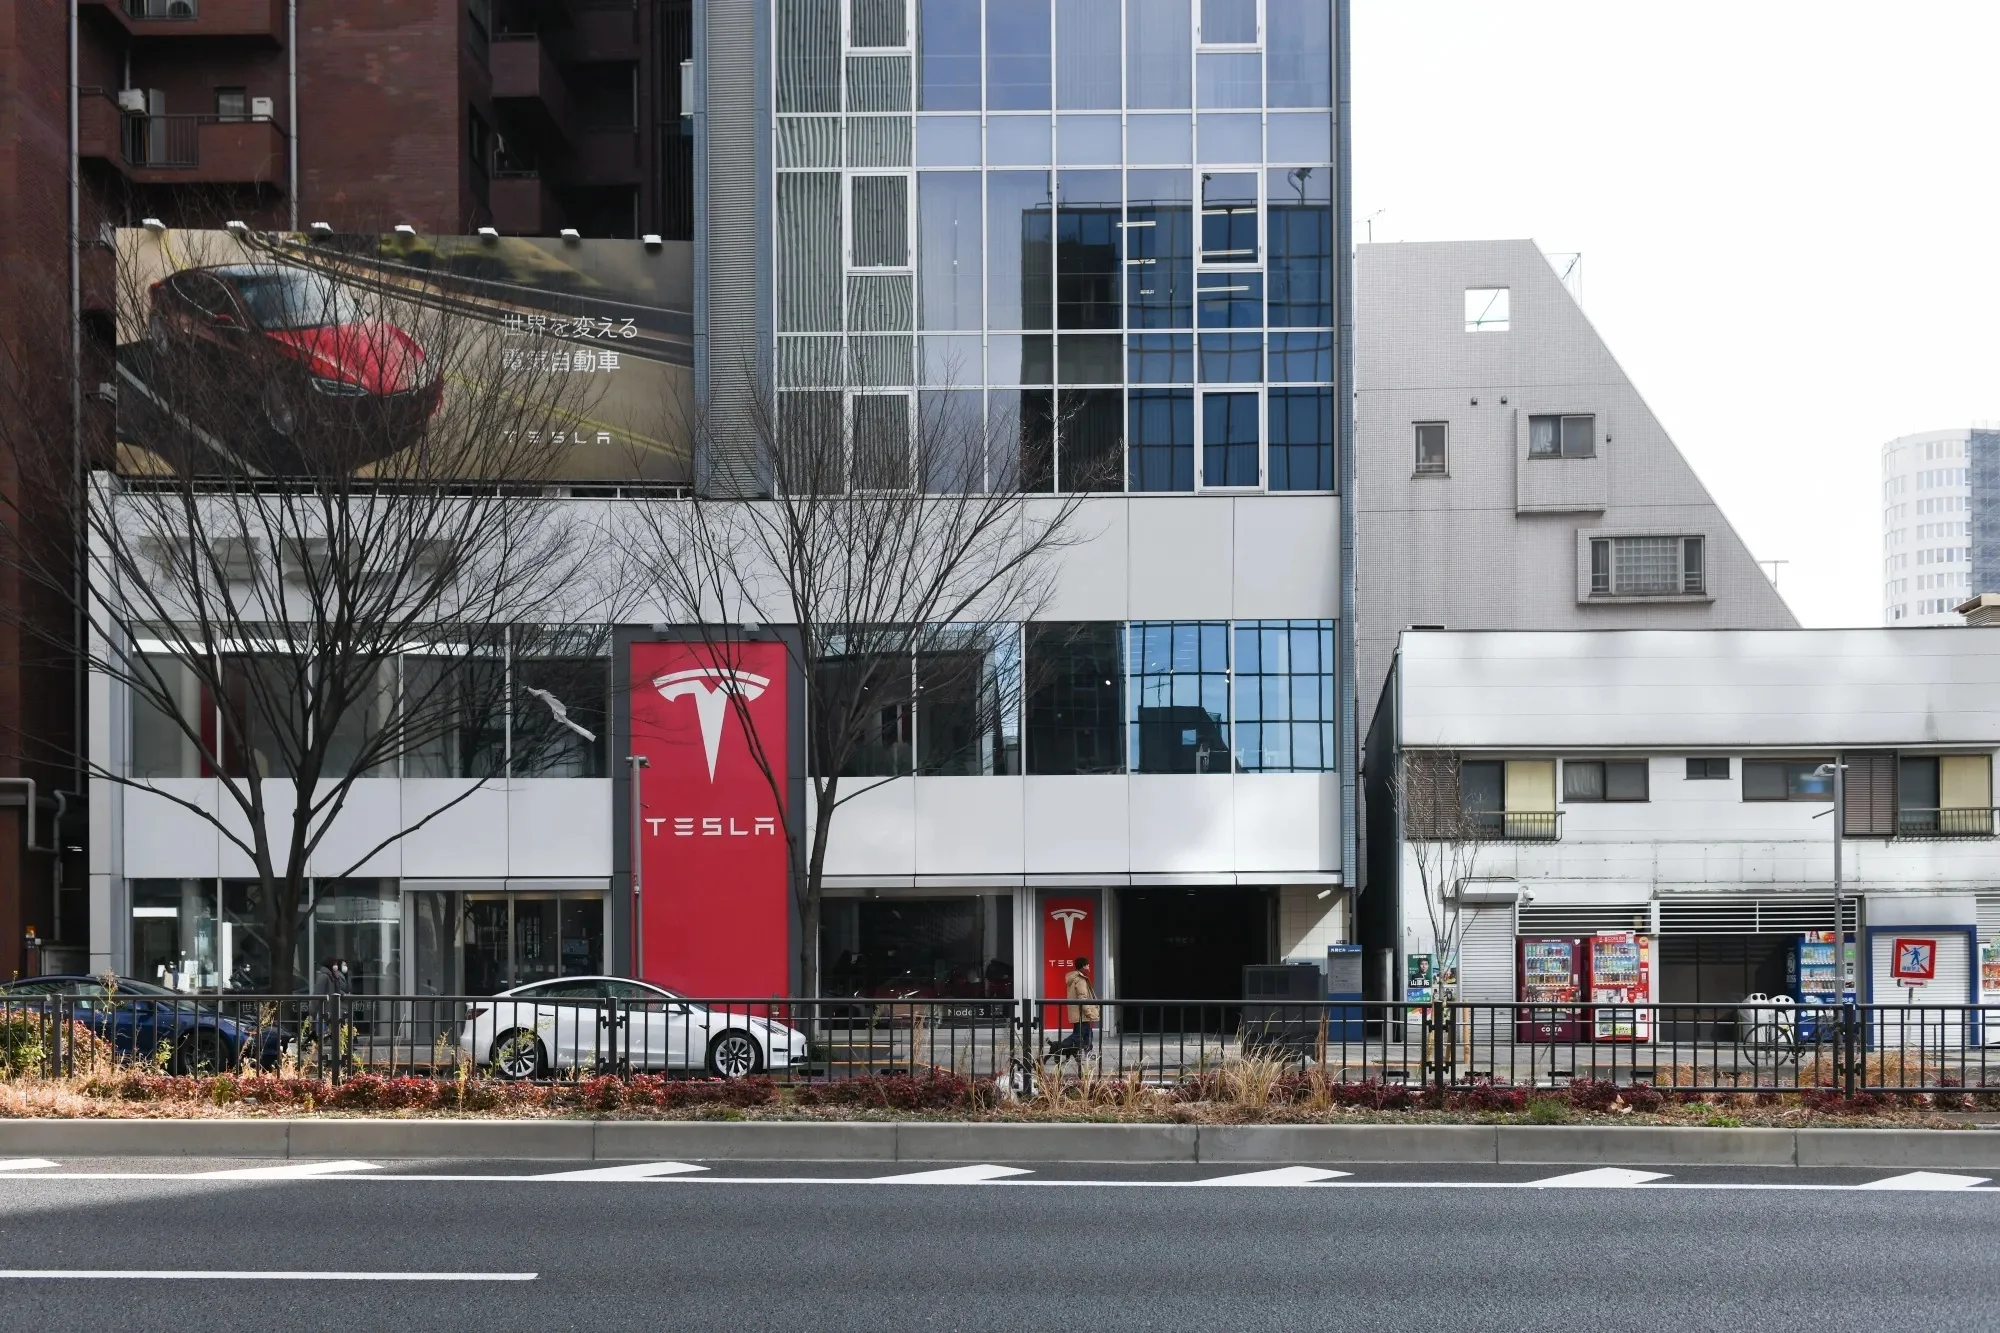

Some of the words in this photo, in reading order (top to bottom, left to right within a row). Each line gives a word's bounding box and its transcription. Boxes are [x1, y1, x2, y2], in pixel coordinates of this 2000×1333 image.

[502, 314, 638, 339] 世界を変える
[504, 431, 611, 444] TESLA
[645, 817, 775, 836] TESLA
[1048, 959, 1074, 967] TES
[978, 1008, 985, 1016] 3
